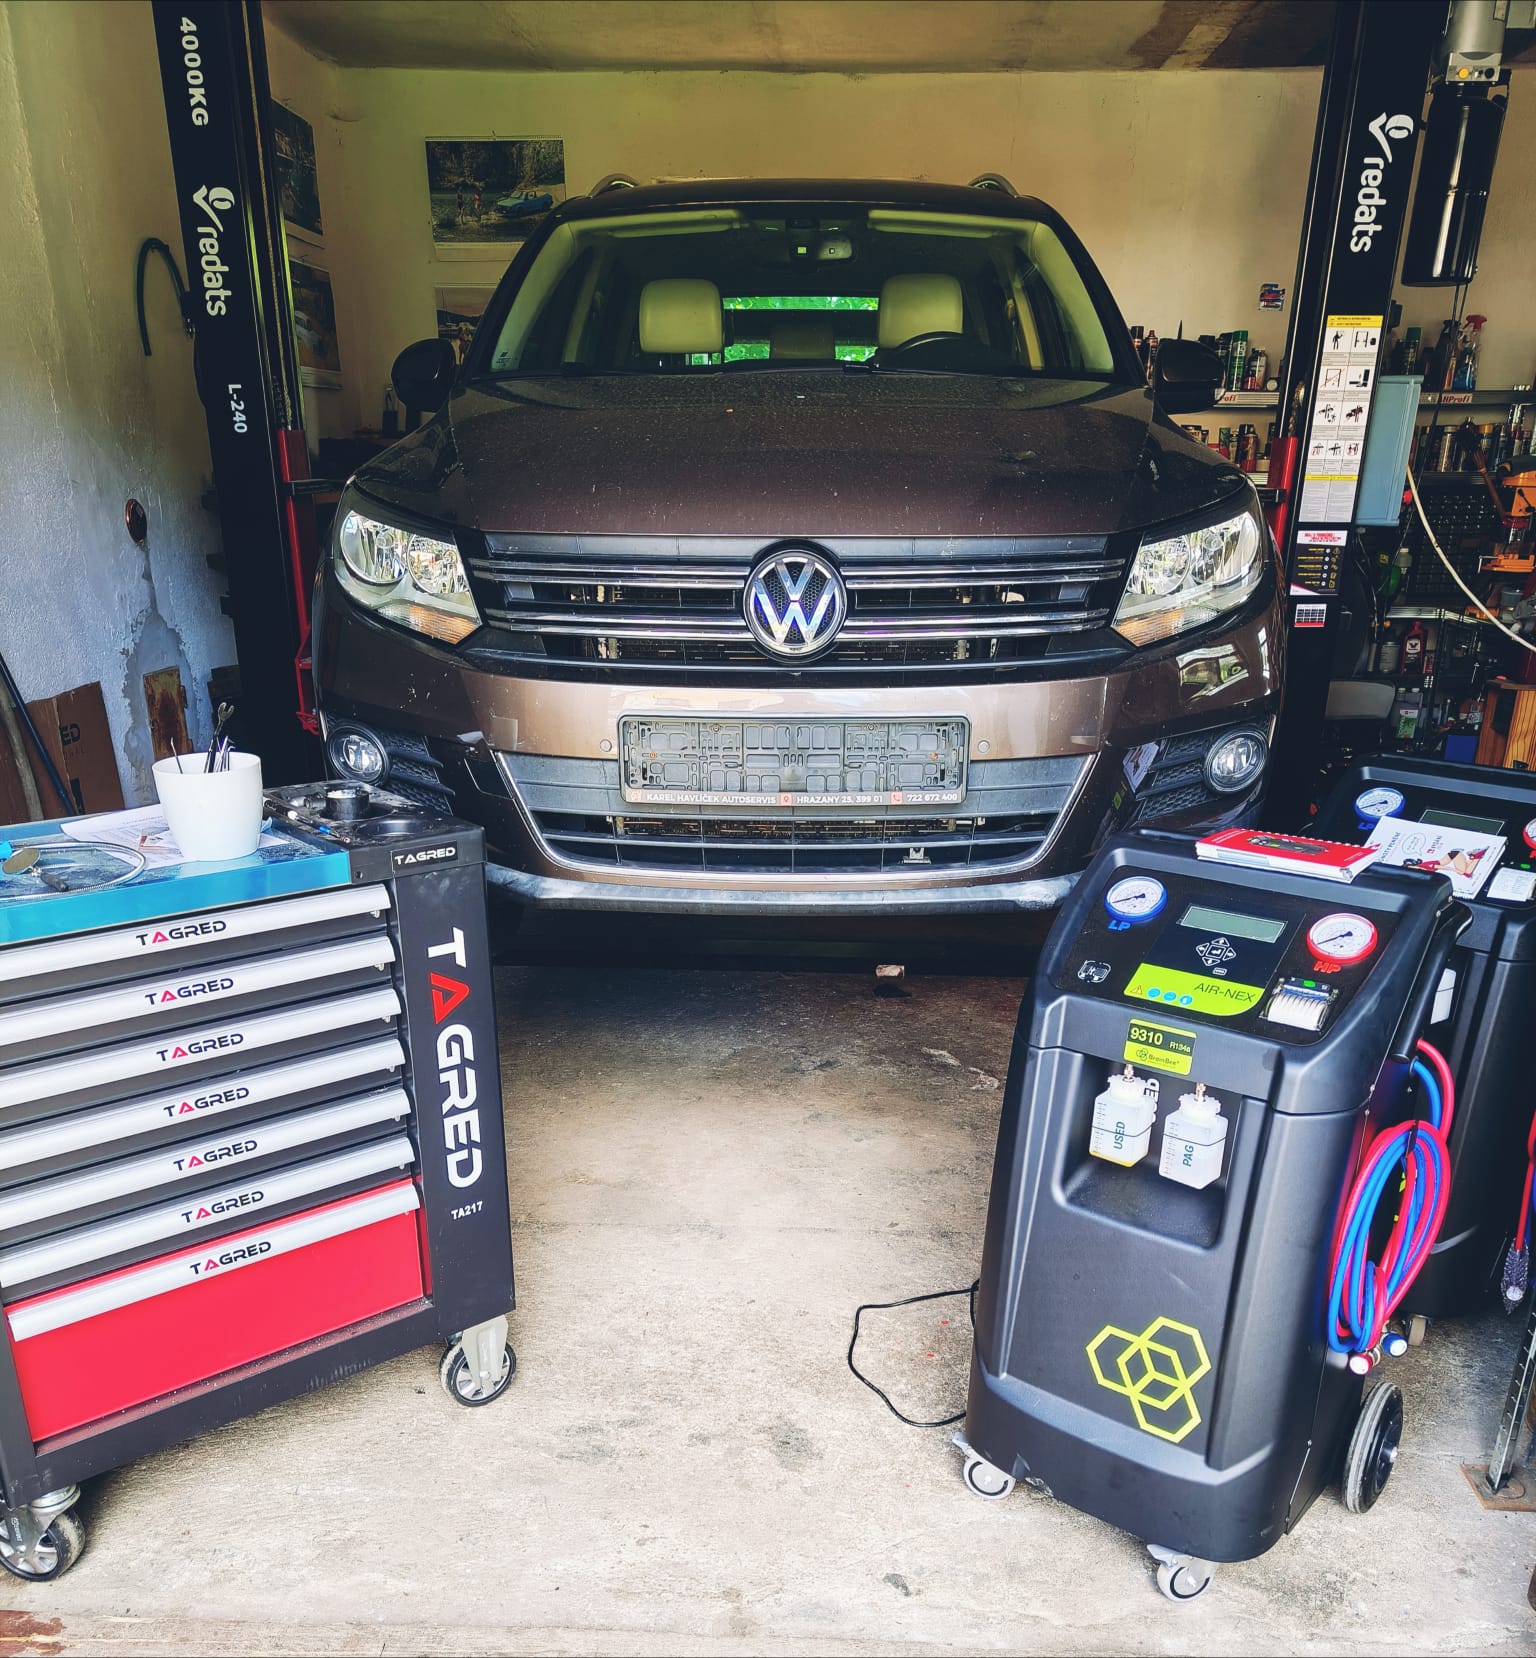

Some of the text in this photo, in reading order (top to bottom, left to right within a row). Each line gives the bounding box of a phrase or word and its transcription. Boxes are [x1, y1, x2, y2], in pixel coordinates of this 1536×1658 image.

[180, 17, 209, 126] 4000KG
[228, 383, 247, 434] L-240
[646, 793, 677, 801] KAREL
[721, 795, 777, 804] AUTOSERVIS
[797, 795, 840, 804] HRAZANY
[855, 795, 871, 804] 399
[873, 795, 883, 803] 01
[907, 793, 923, 802] 722
[941, 793, 958, 801] 400
[394, 846, 457, 866] TAGRED
[136, 920, 227, 947] TAGRED
[1108, 919, 1131, 931] LP
[1313, 961, 1342, 974] HP
[145, 978, 234, 1006] TAGRED
[1194, 981, 1257, 1004] AIR-NEX
[156, 1033, 244, 1062] TAGRED
[1130, 1027, 1191, 1053] 9310 R134a
[427, 926, 483, 1188] TAGRED
[164, 1087, 250, 1119] TAGRED
[1113, 1121, 1126, 1150] USED
[173, 1139, 258, 1172] TAGRED
[1182, 1144, 1195, 1167] PAG
[181, 1191, 264, 1224] TAGRED
[451, 1201, 484, 1221] TA217
[190, 1241, 271, 1276] TAGRED
